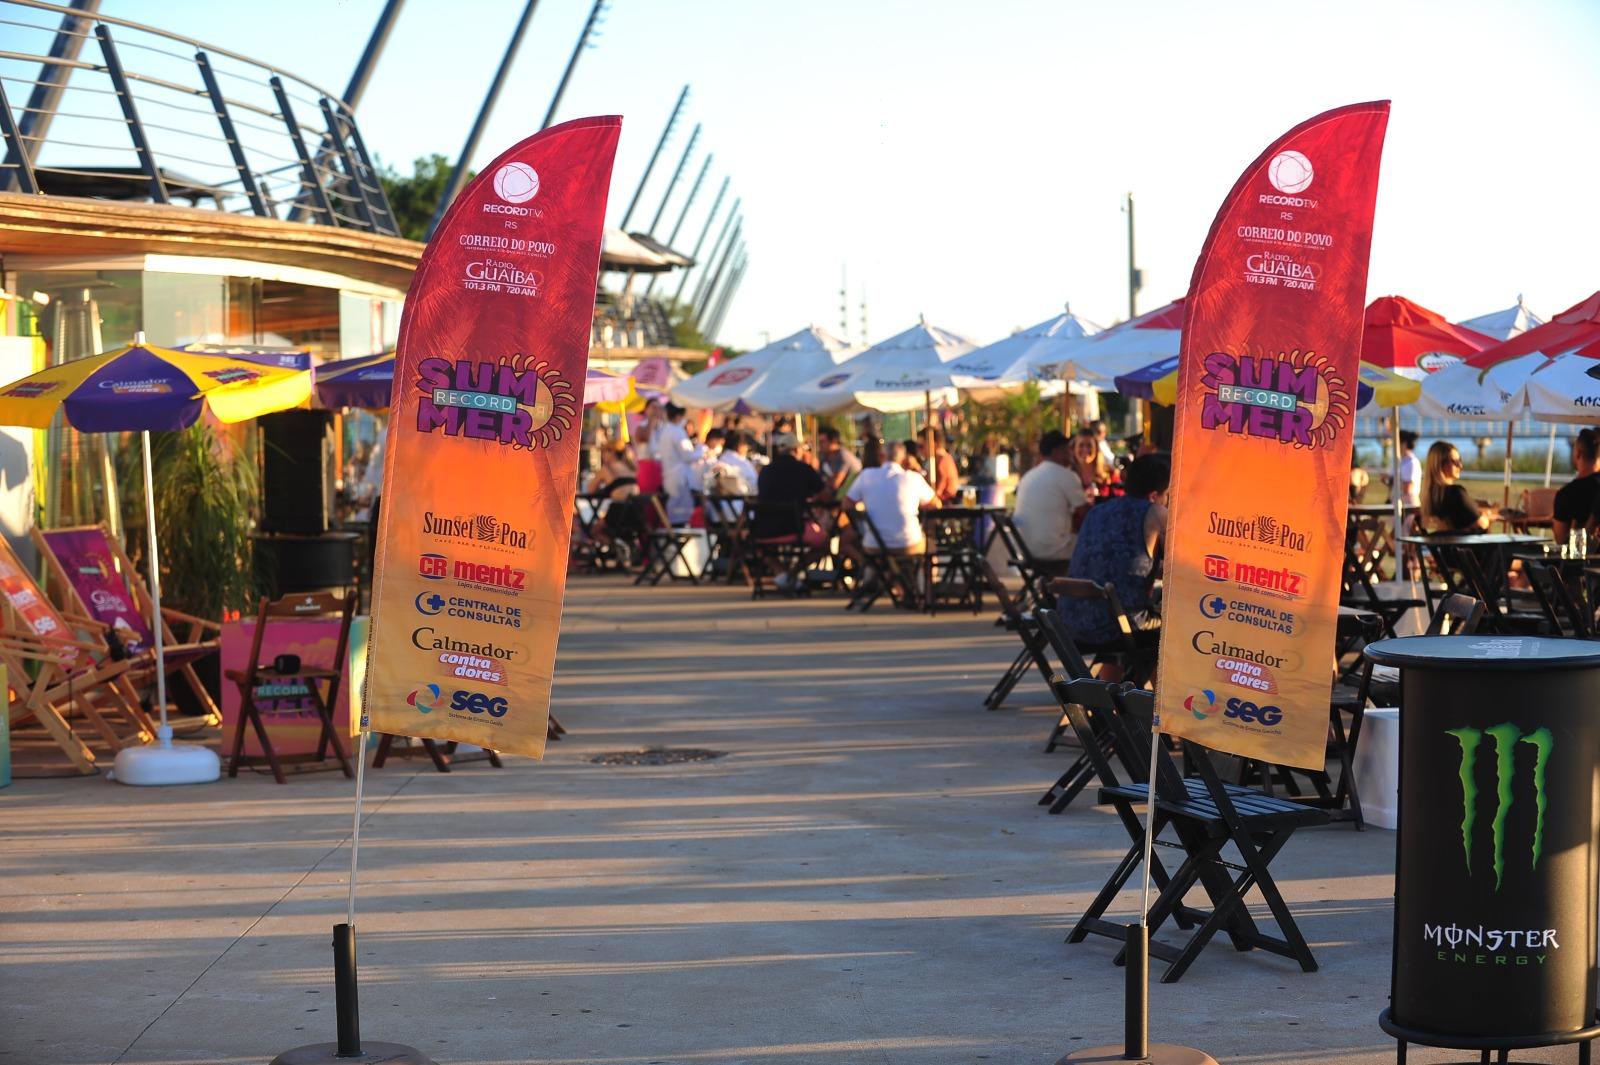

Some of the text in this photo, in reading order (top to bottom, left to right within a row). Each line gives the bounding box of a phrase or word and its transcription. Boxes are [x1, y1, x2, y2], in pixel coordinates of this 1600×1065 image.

[504, 220, 518, 230] RS
[1280, 212, 1293, 221] RS
[459, 234, 508, 249] CORREIO
[511, 238, 525, 251] DO
[528, 241, 555, 255] POVO
[1237, 226, 1285, 241] CORREIO
[1287, 230, 1301, 242] DO
[1305, 233, 1333, 247] POVO
[464, 281, 536, 296] 101.3 FM 720 AM
[1265, 276, 1278, 286] FM
[1283, 279, 1298, 288] 720
[1298, 281, 1314, 290] AM
[416, 357, 538, 407] SUM
[1200, 352, 1319, 404] SUM
[436, 391, 513, 411] RECORD
[1221, 387, 1293, 409] RECORD
[417, 396, 533, 448] MER
[1201, 392, 1314, 446] MER
[423, 511, 474, 539] Sunset
[500, 522, 527, 549] Poa
[1208, 511, 1256, 541] Sunset
[1280, 523, 1304, 551] Poa
[419, 557, 525, 589] CR mentz
[1204, 557, 1302, 594] CR mentz
[449, 597, 521, 617] CENTRAL DE
[1230, 600, 1294, 623] CENTRAL DE
[448, 608, 521, 628] CONSULTAS
[1228, 612, 1292, 634] CONSULTAS
[411, 626, 514, 661] Calmador
[1191, 630, 1284, 669] Calmador
[440, 653, 491, 669] contra
[1216, 659, 1262, 677] contra
[454, 666, 501, 682] dores
[1231, 672, 1270, 691] dores
[257, 684, 309, 696] RECORD
[1424, 922, 1560, 951] MONSTER
[1437, 951, 1546, 965] ENERGY
